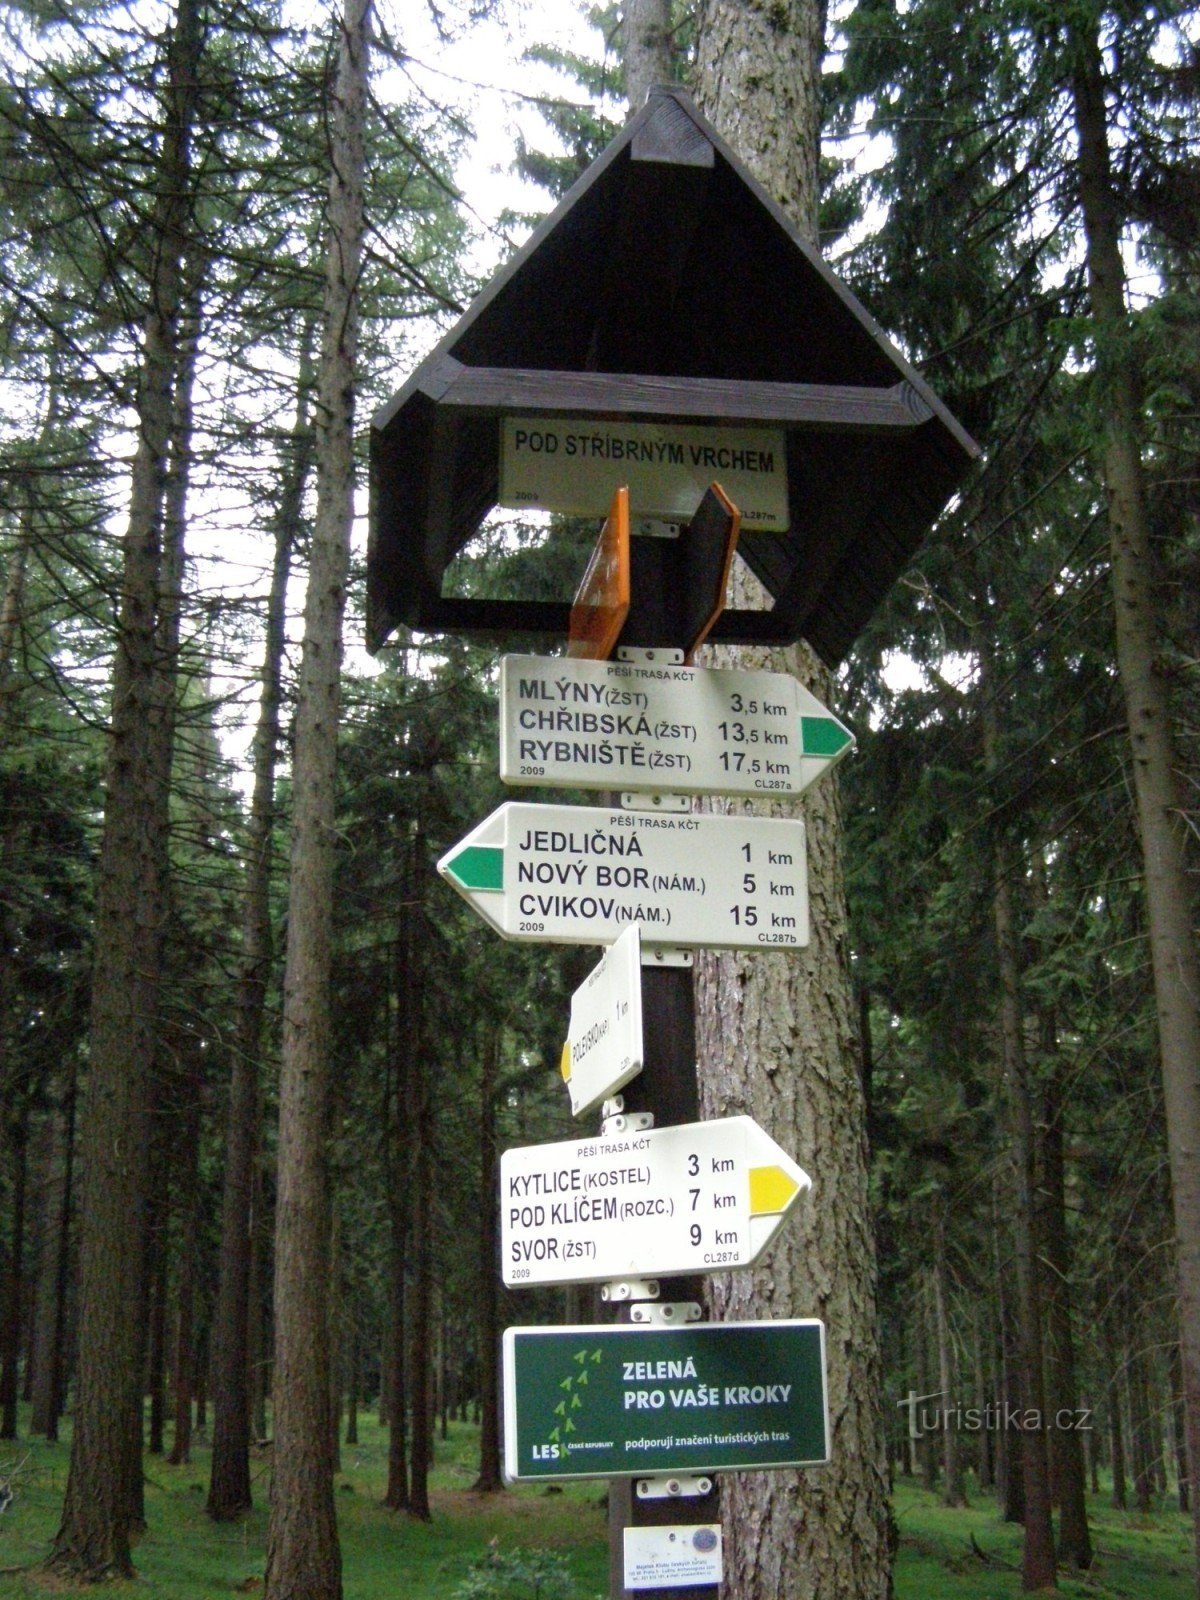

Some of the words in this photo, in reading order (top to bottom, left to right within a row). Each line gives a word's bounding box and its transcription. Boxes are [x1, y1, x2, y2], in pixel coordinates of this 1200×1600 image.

[515, 430, 558, 452] POD
[565, 431, 684, 465] STŘÍBRNÝM
[690, 445, 774, 473] VRCHEM
[515, 490, 539, 501] 2009
[634, 668, 670, 680] TRASA
[673, 670, 695, 682] KČT
[730, 693, 758, 715] 3,5
[763, 701, 788, 717] km
[718, 721, 759, 744] 13,5
[764, 729, 788, 745] km
[520, 765, 545, 776] 2009
[719, 750, 760, 774] 17,5
[764, 759, 790, 775] km
[755, 779, 792, 790] CL287a
[610, 815, 636, 827] PĚŠÍ
[638, 817, 675, 829] TRASA
[678, 818, 700, 831] KČT
[519, 829, 643, 857] JEDLIČNÁ
[741, 843, 751, 863] 1
[768, 850, 793, 866] km
[518, 859, 588, 885] NOVÝ
[743, 873, 756, 894] 5
[769, 881, 795, 897] km
[519, 922, 545, 932] 2009
[730, 905, 758, 927] 15
[771, 912, 796, 929] km
[758, 932, 797, 944] CL287b
[578, 1146, 598, 1158] PĚŠÍ
[599, 1142, 630, 1156] TRASA
[633, 1139, 651, 1151] KČT
[688, 1154, 700, 1177] 3
[712, 1157, 734, 1173] km
[510, 1206, 545, 1229] POD
[689, 1188, 700, 1211] 7
[714, 1193, 736, 1209] km
[690, 1223, 702, 1246] 9
[715, 1229, 738, 1245] km
[704, 1251, 739, 1264] CL287d
[512, 1268, 530, 1279] 2009
[622, 1356, 697, 1380] ZELENÁ
[624, 1390, 665, 1410] PRO
[669, 1384, 719, 1408] VAŠE
[725, 1384, 792, 1405] KROKY
[625, 1435, 673, 1451] podporují
[675, 1432, 713, 1447] značení
[714, 1431, 769, 1446] turistických
[771, 1431, 790, 1443] tras
